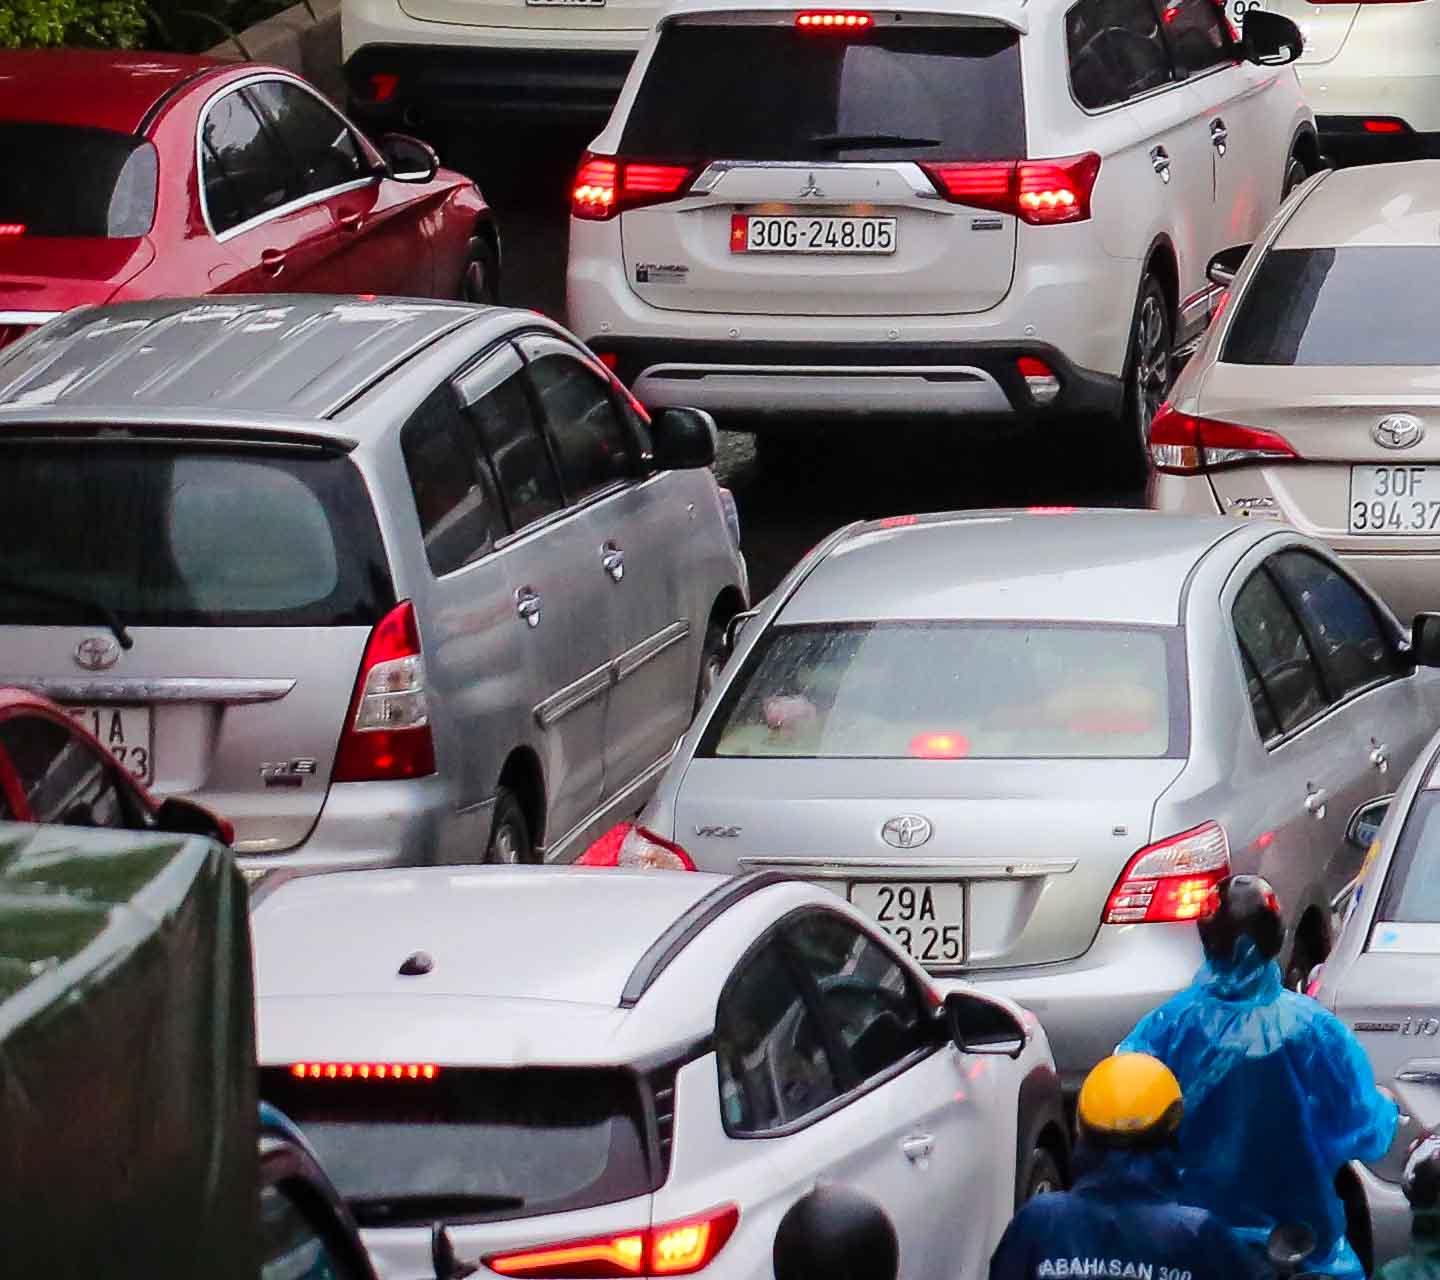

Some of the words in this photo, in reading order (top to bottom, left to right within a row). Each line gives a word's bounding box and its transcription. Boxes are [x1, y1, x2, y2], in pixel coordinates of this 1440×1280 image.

[751, 219, 892, 249] 30G-248.05
[1375, 467, 1425, 495] 30F
[877, 886, 936, 921] 29A
[1039, 1258, 1154, 1280] ABAHASAN
